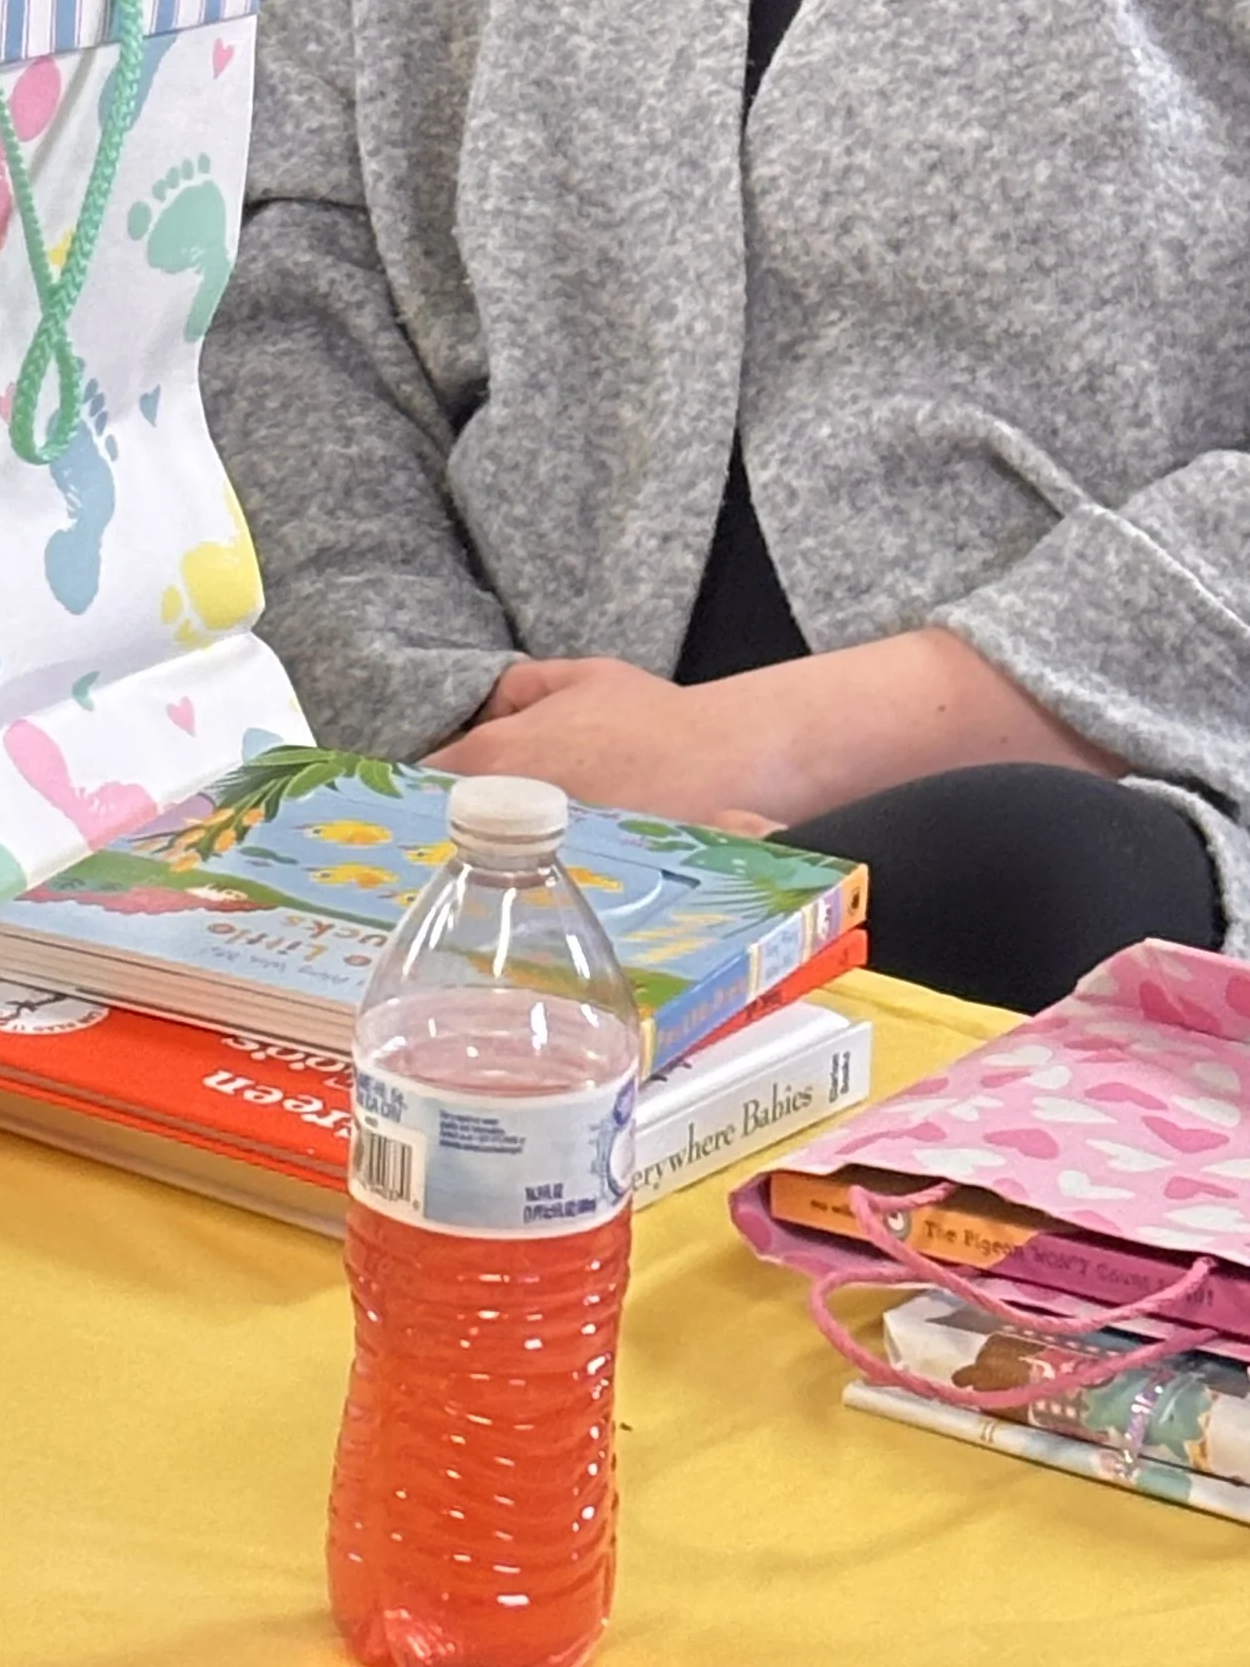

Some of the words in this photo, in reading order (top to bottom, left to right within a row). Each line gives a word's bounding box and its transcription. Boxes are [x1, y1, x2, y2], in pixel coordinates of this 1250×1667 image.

[282, 914, 388, 948] ucks
[630, 1122, 737, 1192] erywhere
[741, 1082, 814, 1138] Babies
[924, 1219, 957, 1244] The
[963, 1228, 1026, 1261] Pigeon
